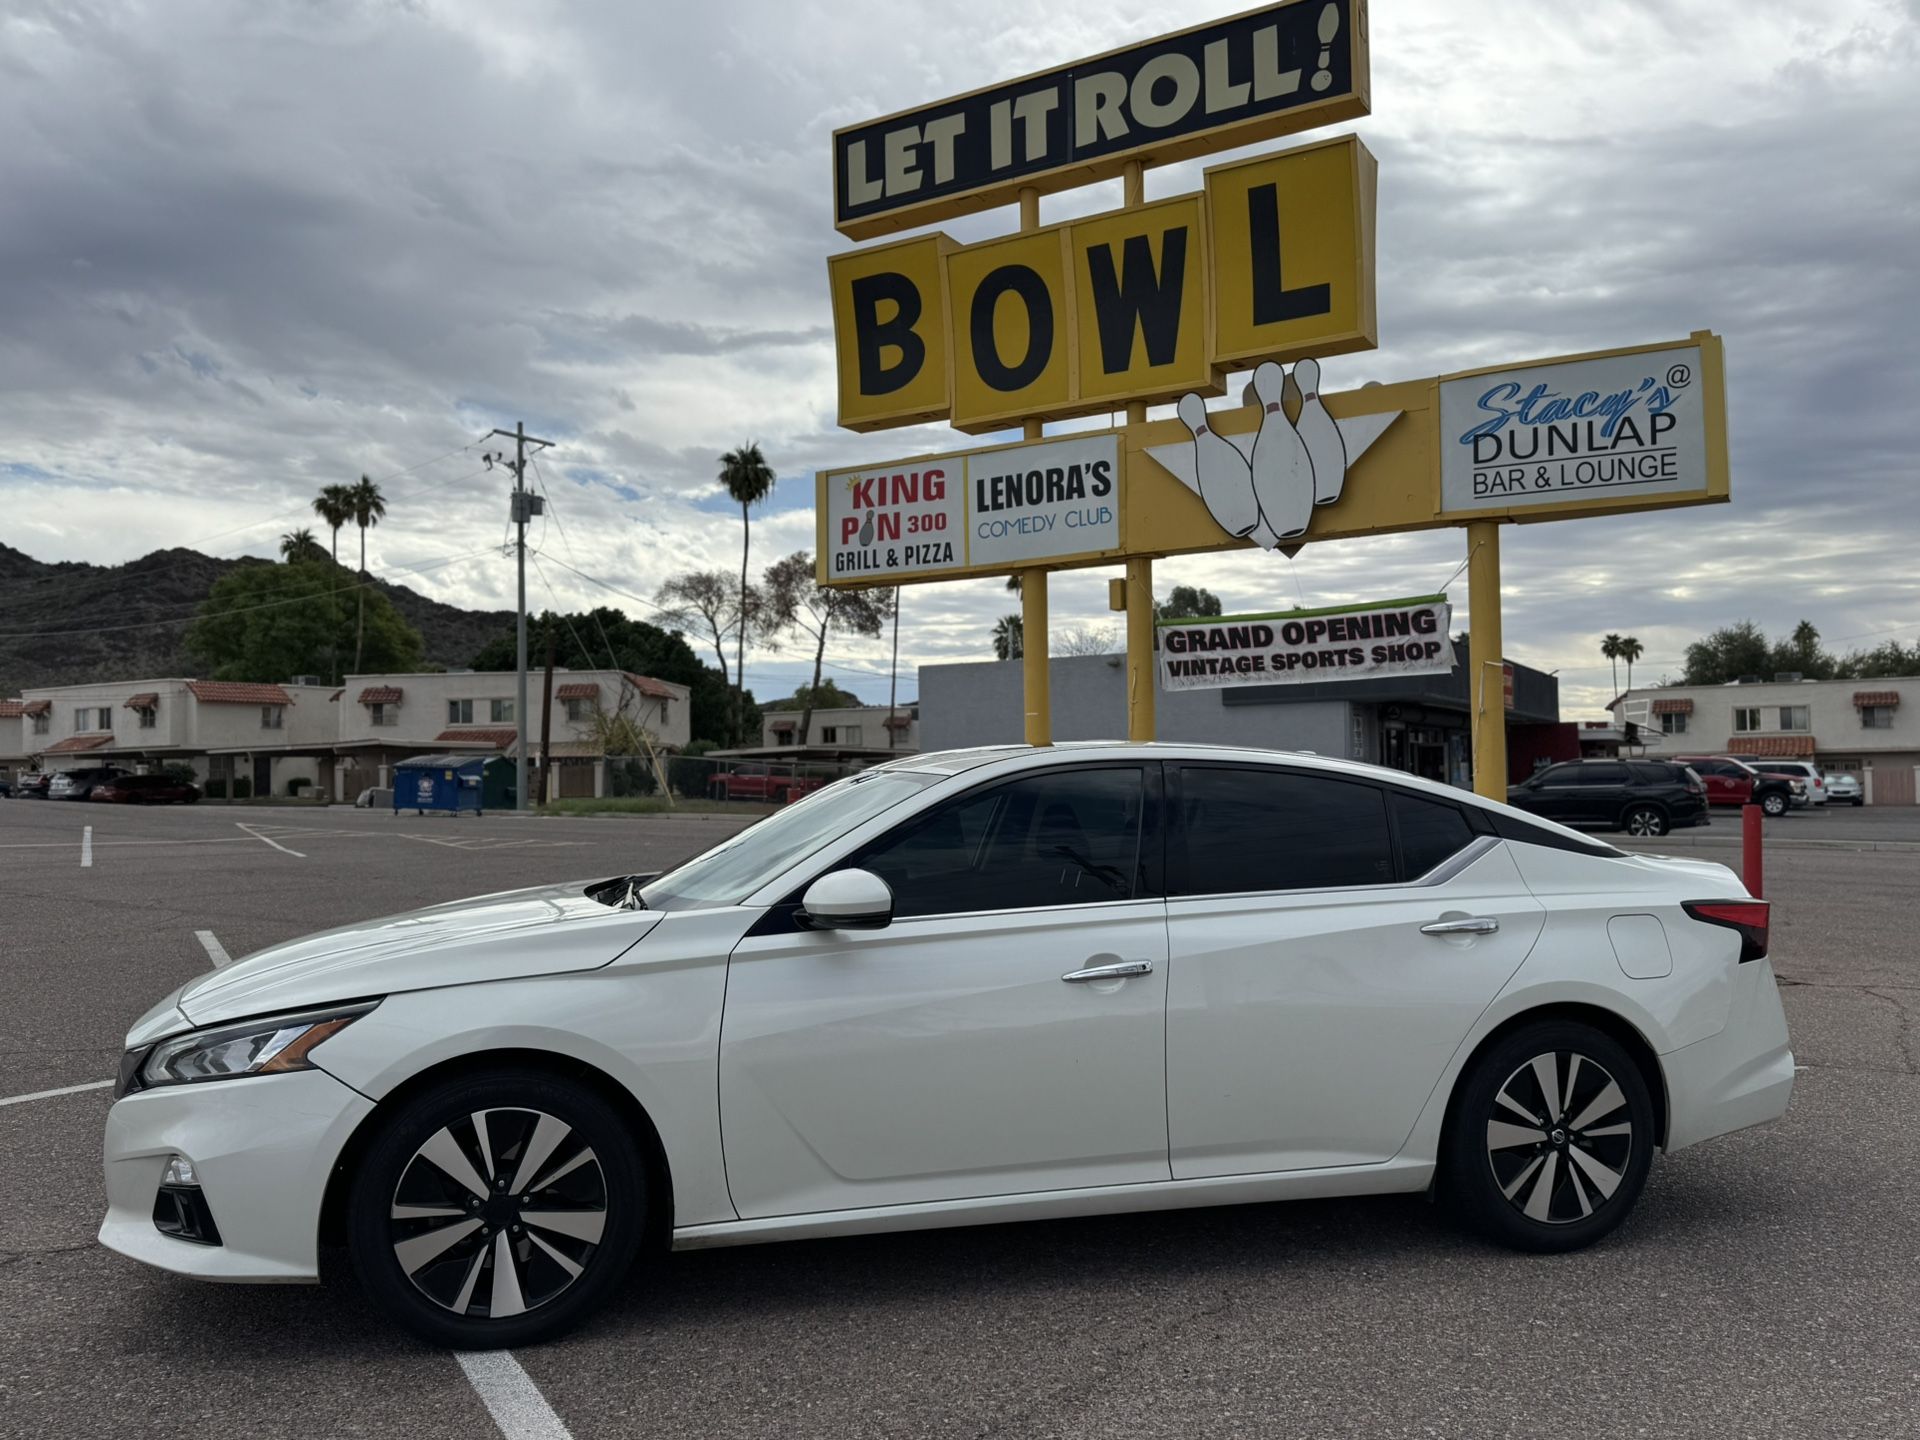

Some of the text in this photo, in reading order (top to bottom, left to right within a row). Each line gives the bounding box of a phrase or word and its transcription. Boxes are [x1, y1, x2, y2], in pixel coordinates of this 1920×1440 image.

[847, 112, 966, 208] LET
[990, 86, 1059, 172] IT
[851, 182, 1331, 396] BOWL
[1459, 364, 1691, 445] Stacy's @
[1473, 411, 1677, 465] DUNLAP
[852, 469, 946, 510] KING
[976, 460, 1112, 513] LENORA'S
[1473, 452, 1678, 495] BAR & LOUNGE
[907, 512, 947, 534] 300
[977, 506, 1113, 540] COMEDY CLUB
[835, 542, 954, 573] GRILL & PIZZA
[1165, 609, 1437, 654] GRAND OPENING
[1166, 641, 1442, 678] VINTAGE SPORTS SHOP
